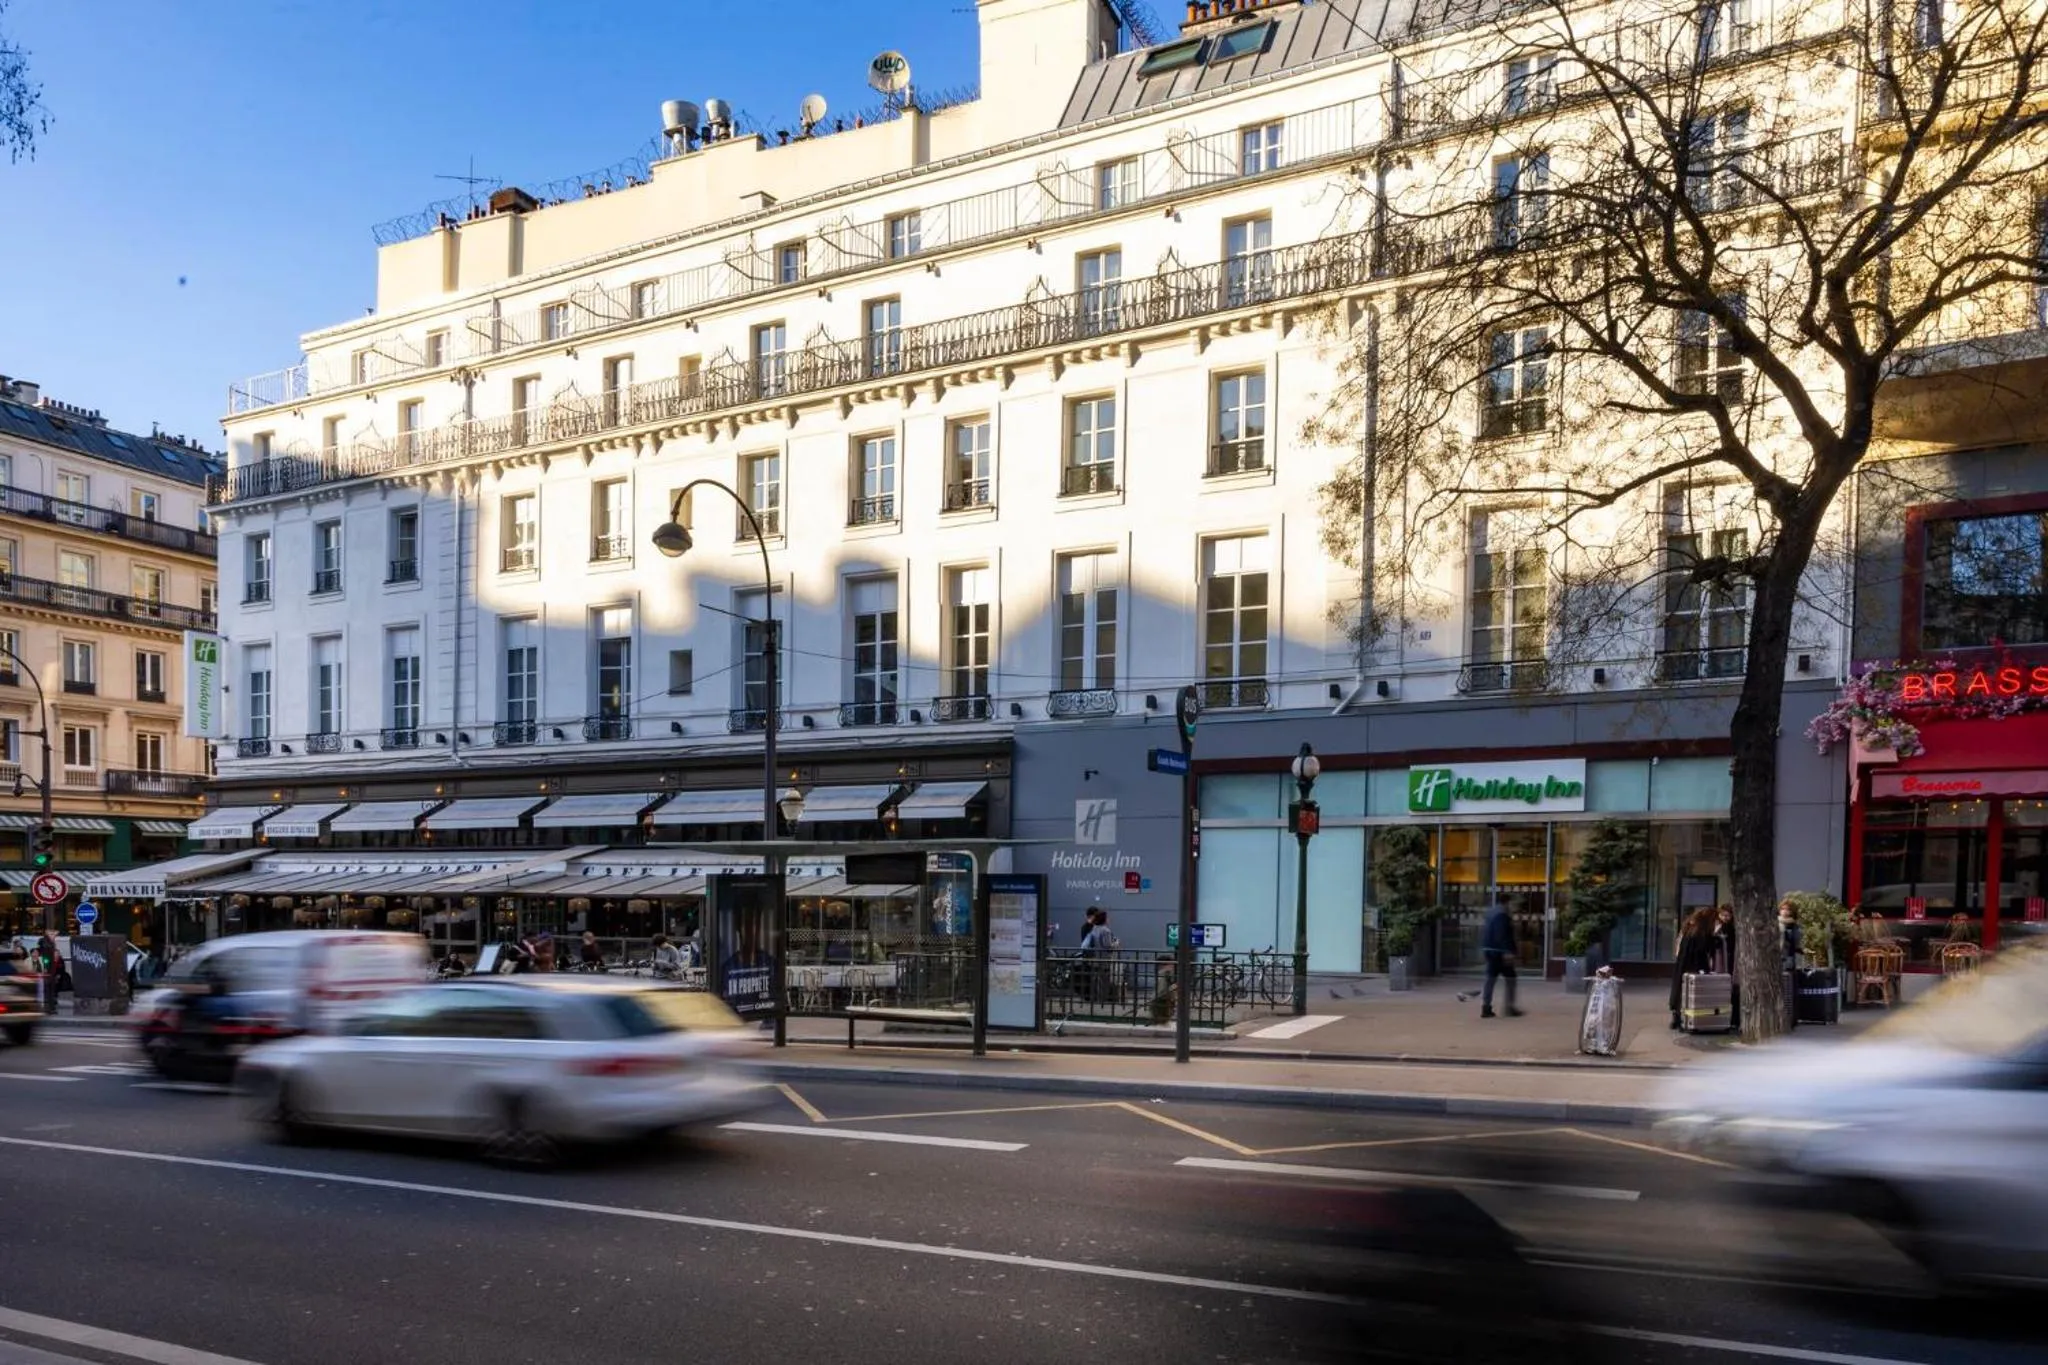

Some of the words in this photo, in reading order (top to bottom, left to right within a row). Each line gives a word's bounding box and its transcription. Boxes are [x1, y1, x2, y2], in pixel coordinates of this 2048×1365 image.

[198, 666, 212, 710] Holiday
[1902, 666, 2048, 700] BRASS
[200, 711, 212, 730] Inn
[1452, 776, 1543, 805] Holiday
[1544, 774, 1583, 798] Inn
[1051, 850, 1113, 872] Holiday
[1114, 849, 1141, 868] Inn
[89, 884, 165, 896] BRASSERIE
[1066, 880, 1091, 889] PARIS
